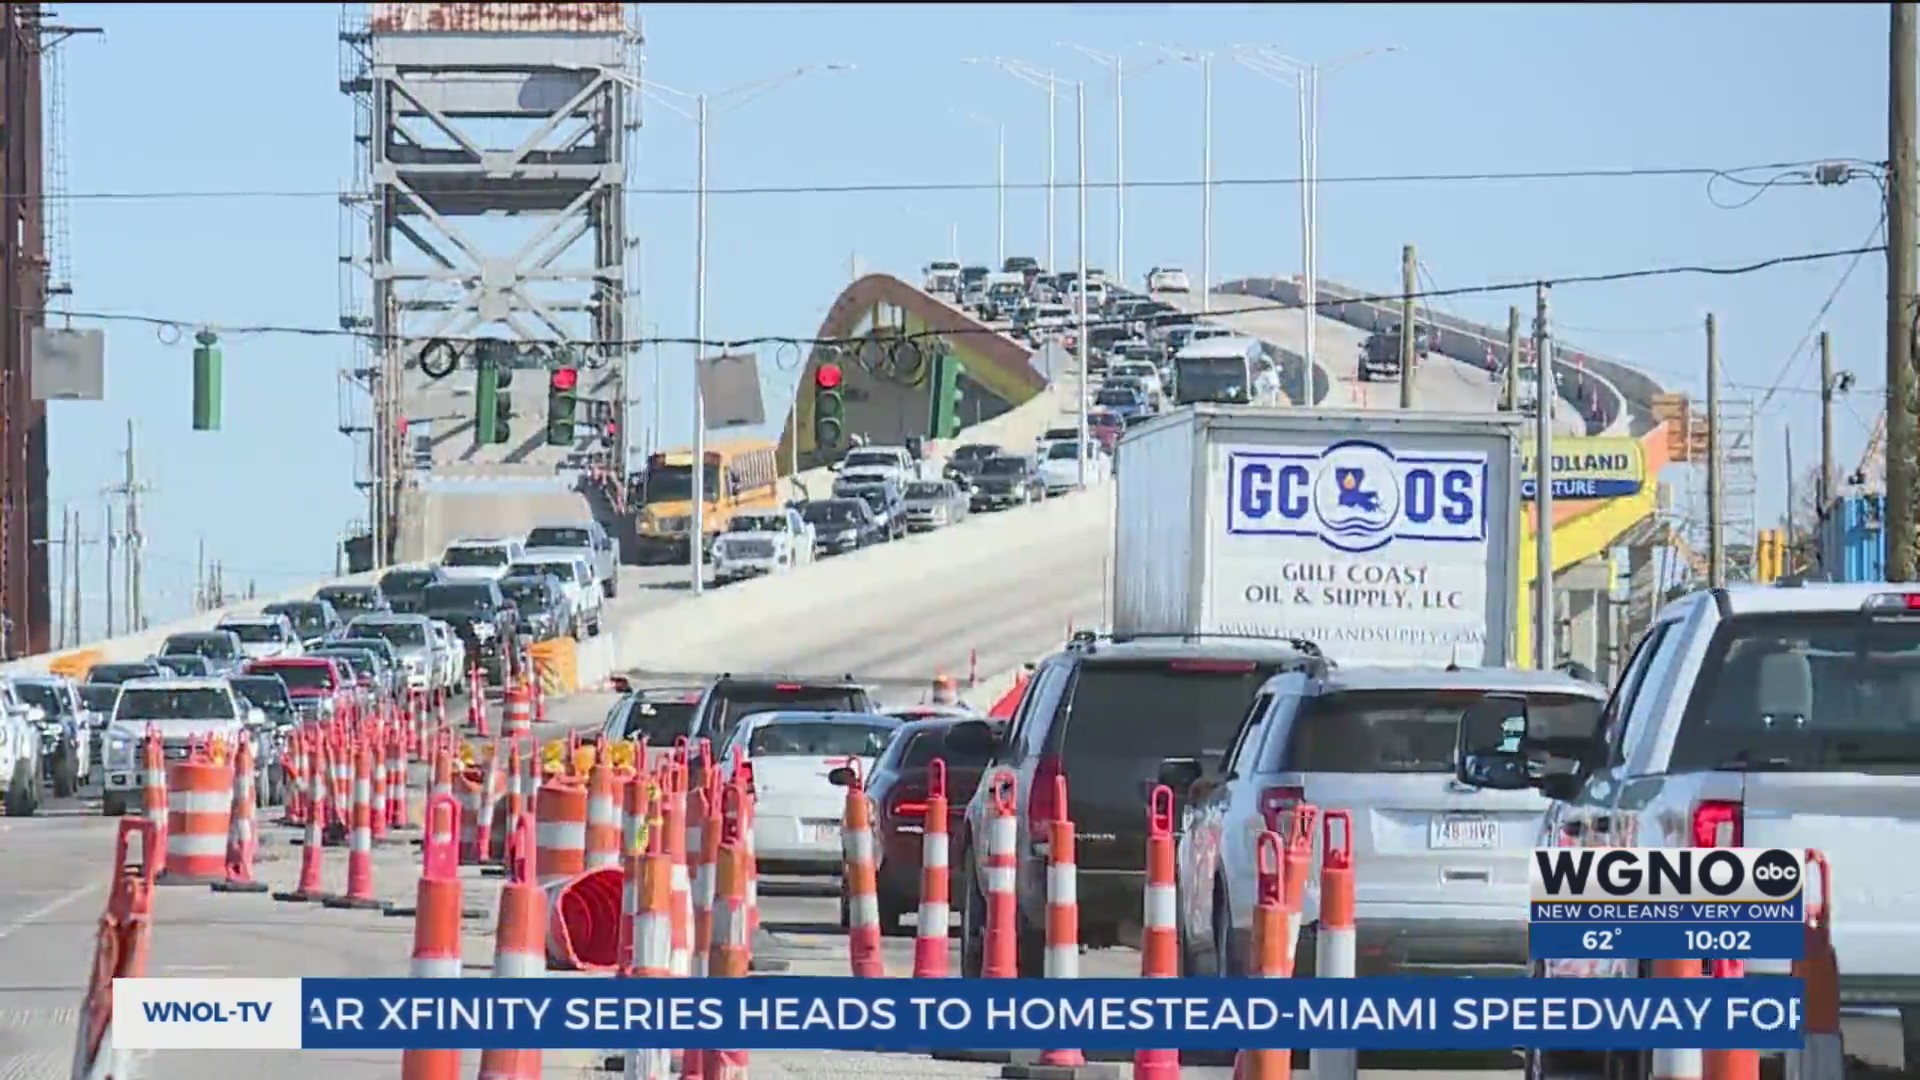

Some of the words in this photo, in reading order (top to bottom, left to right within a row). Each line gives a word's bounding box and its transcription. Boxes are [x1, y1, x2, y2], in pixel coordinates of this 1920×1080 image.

[1540, 455, 1628, 473] OLLAND
[1240, 463, 1309, 519] GC
[1404, 468, 1473, 524] OS
[1282, 562, 1337, 582] GULF
[1347, 564, 1428, 584] COAST
[1245, 585, 1282, 604] OIL
[1294, 587, 1311, 605] &
[1323, 587, 1413, 608] SUPPLY,
[1423, 590, 1463, 609] LLC
